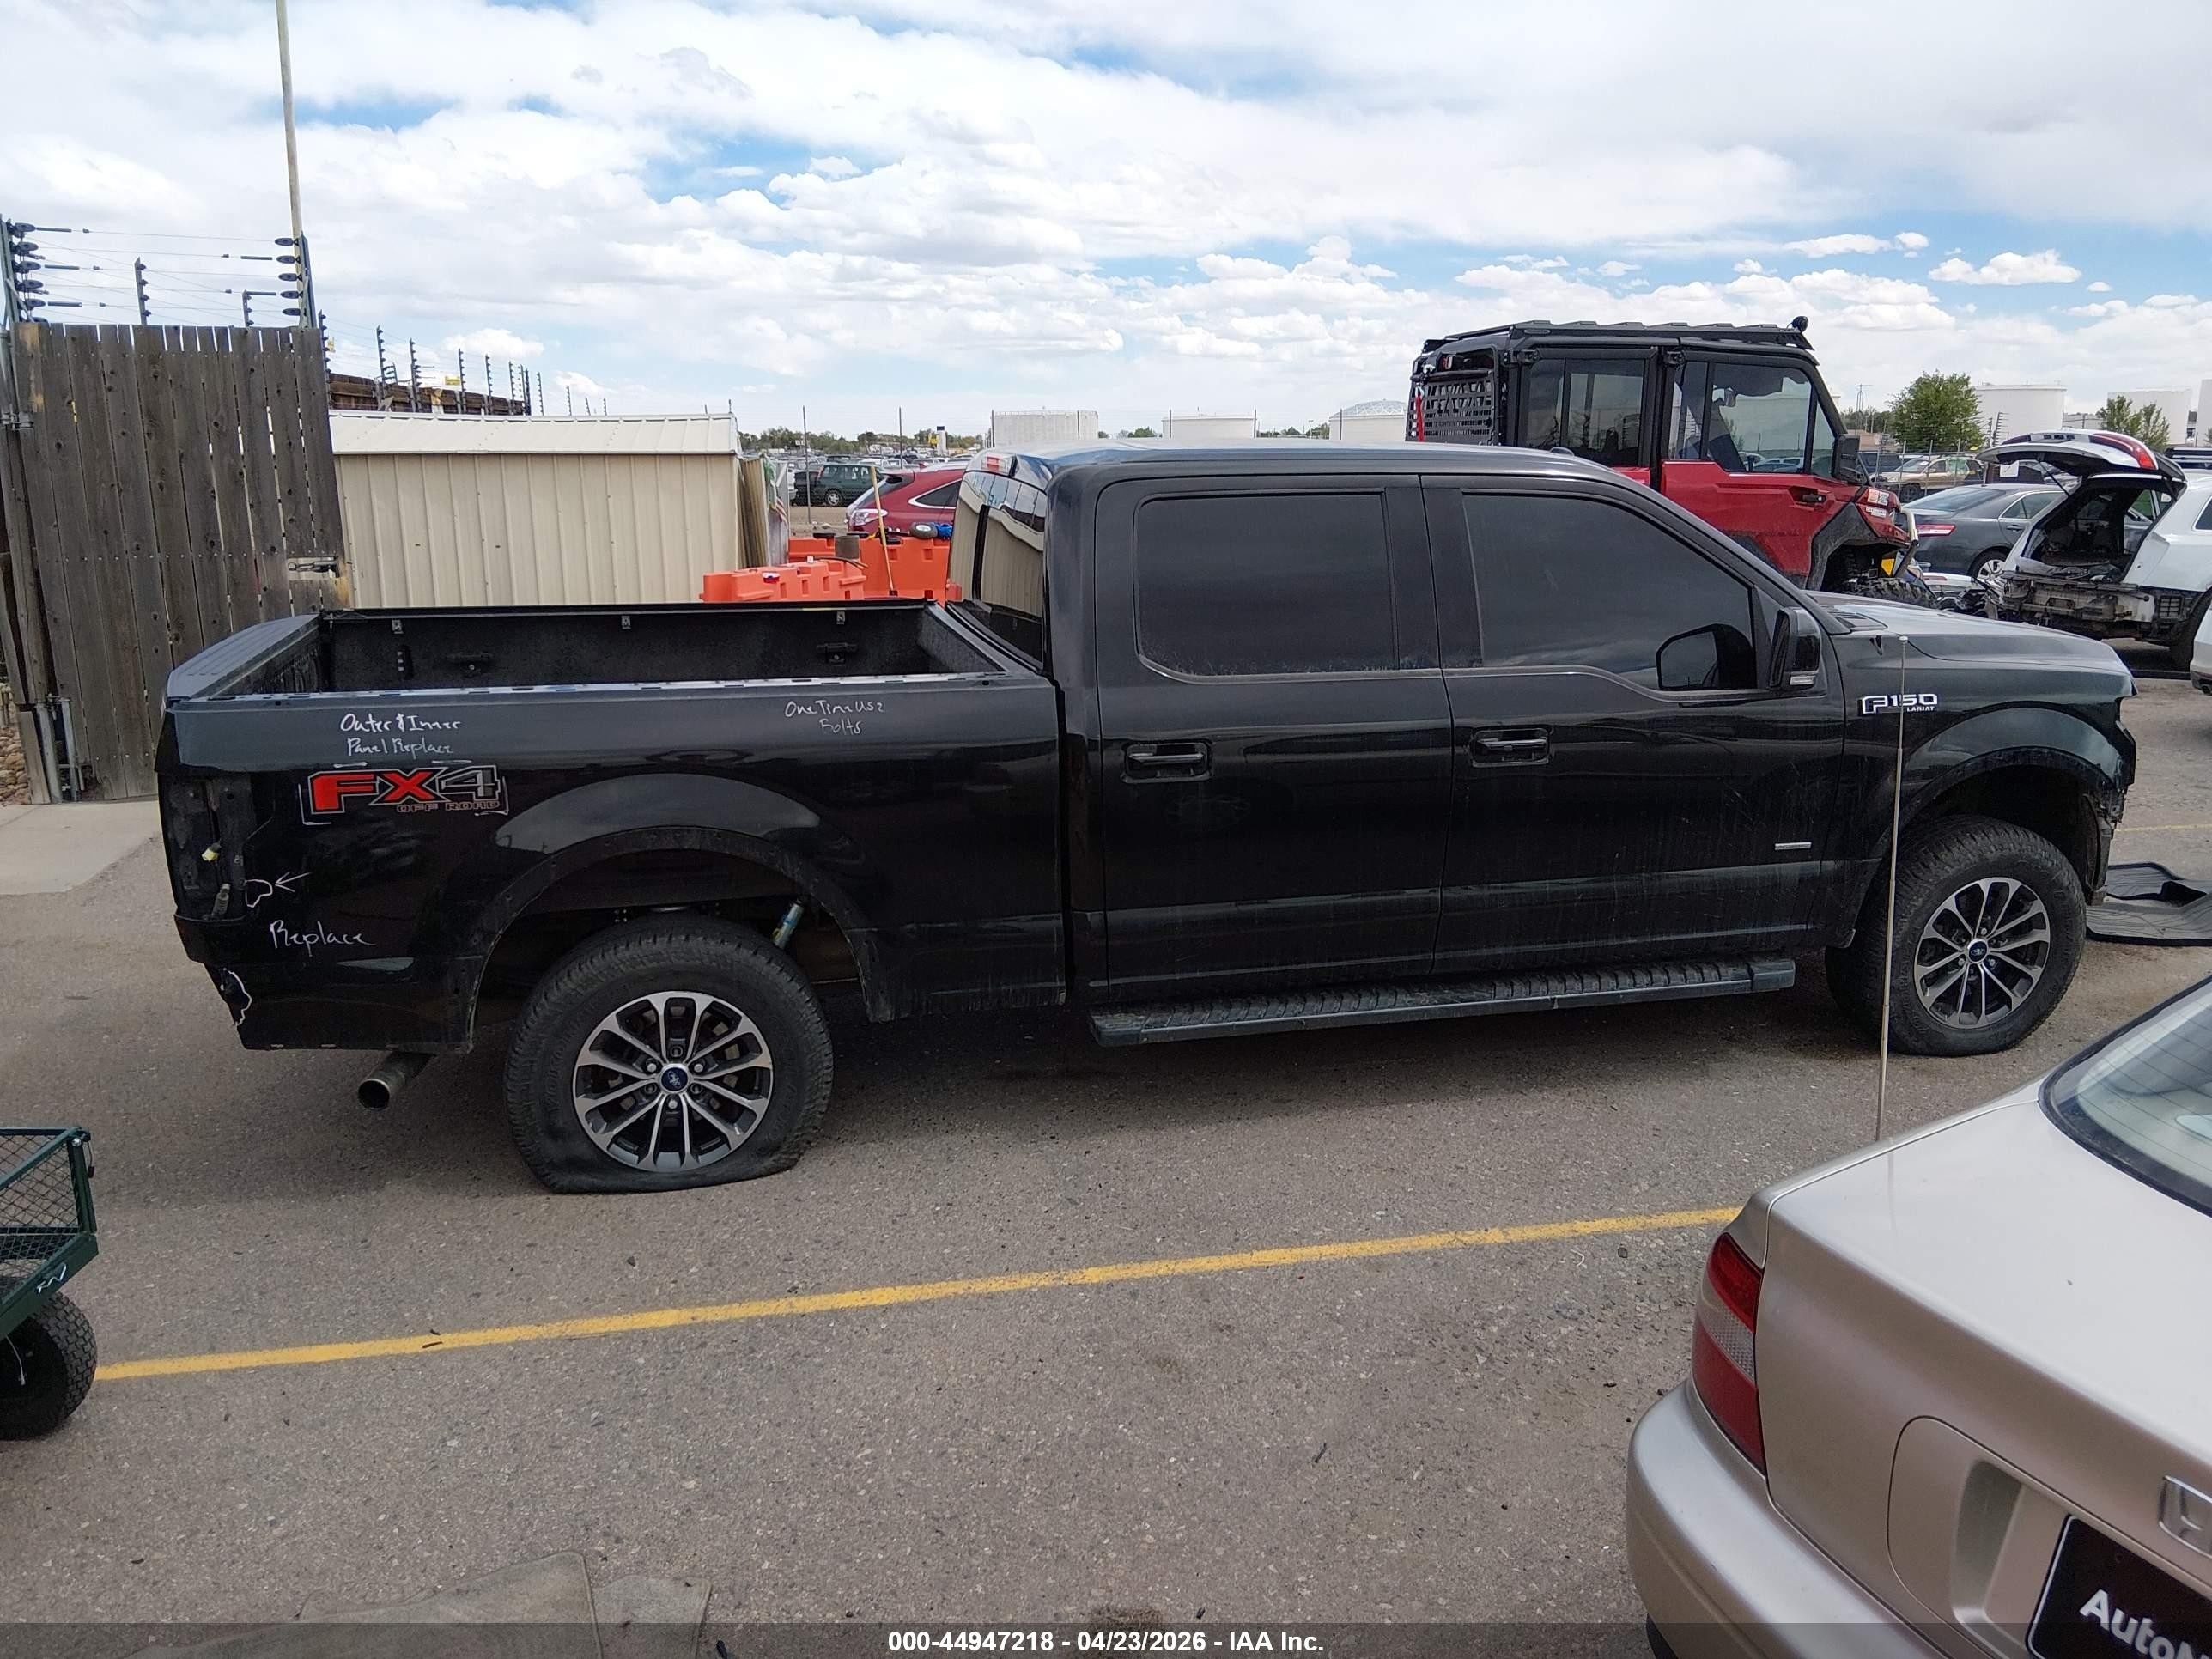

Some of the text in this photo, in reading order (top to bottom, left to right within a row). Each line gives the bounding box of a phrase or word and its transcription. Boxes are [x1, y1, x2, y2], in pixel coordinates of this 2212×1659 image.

[785, 701, 817, 717] One
[815, 700, 853, 714] Time
[340, 713, 392, 732] Outer
[407, 714, 461, 731] Inner
[347, 737, 454, 759] Panel Replace
[308, 765, 501, 814] FX4
[397, 800, 500, 812] OFF ROAD
[270, 919, 377, 957] Replace
